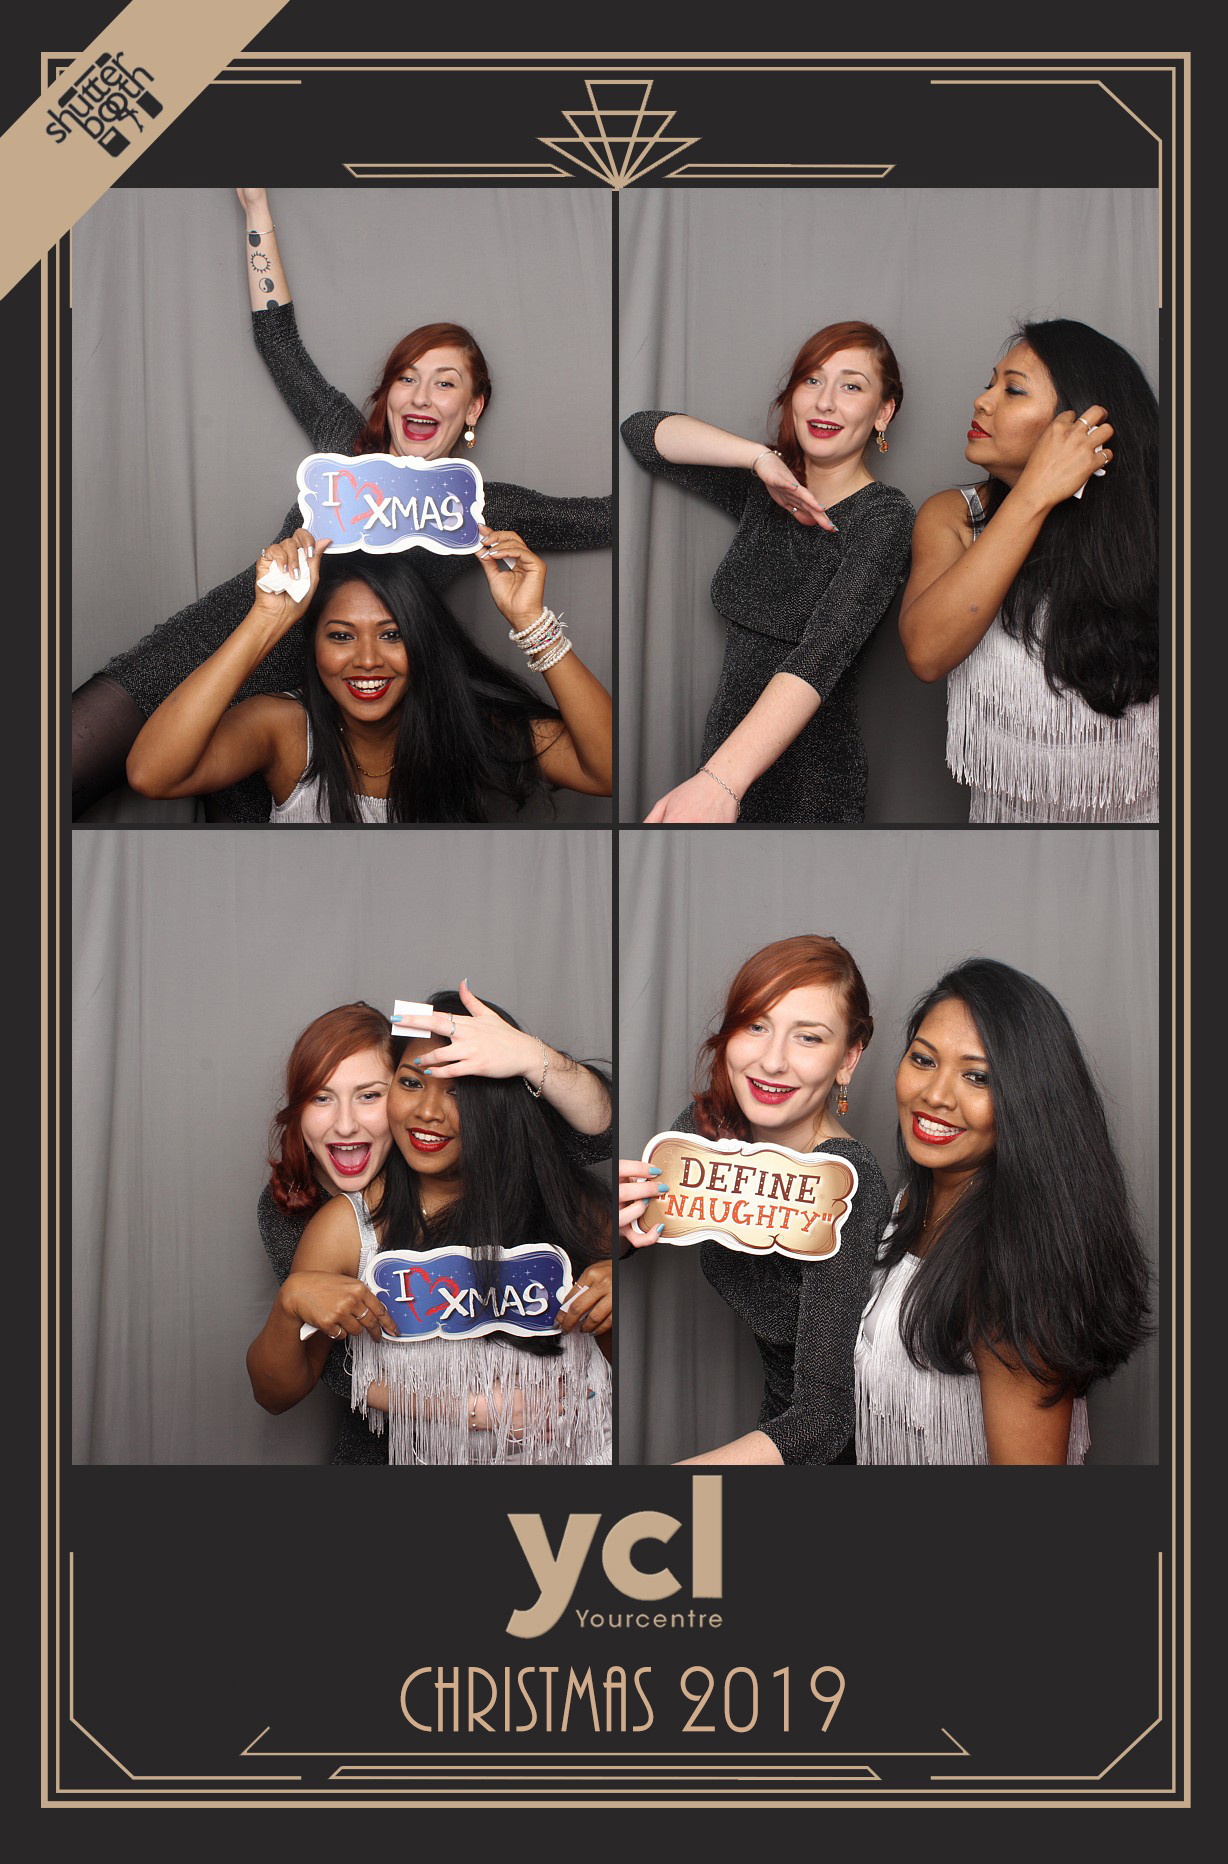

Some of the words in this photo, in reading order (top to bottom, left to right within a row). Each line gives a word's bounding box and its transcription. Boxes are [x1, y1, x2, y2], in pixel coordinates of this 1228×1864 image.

[321, 471, 341, 507] I
[363, 493, 464, 532] XMAS
[679, 1156, 821, 1205] DEFINE
[392, 1269, 415, 1303] I
[440, 1282, 549, 1320] XMAS
